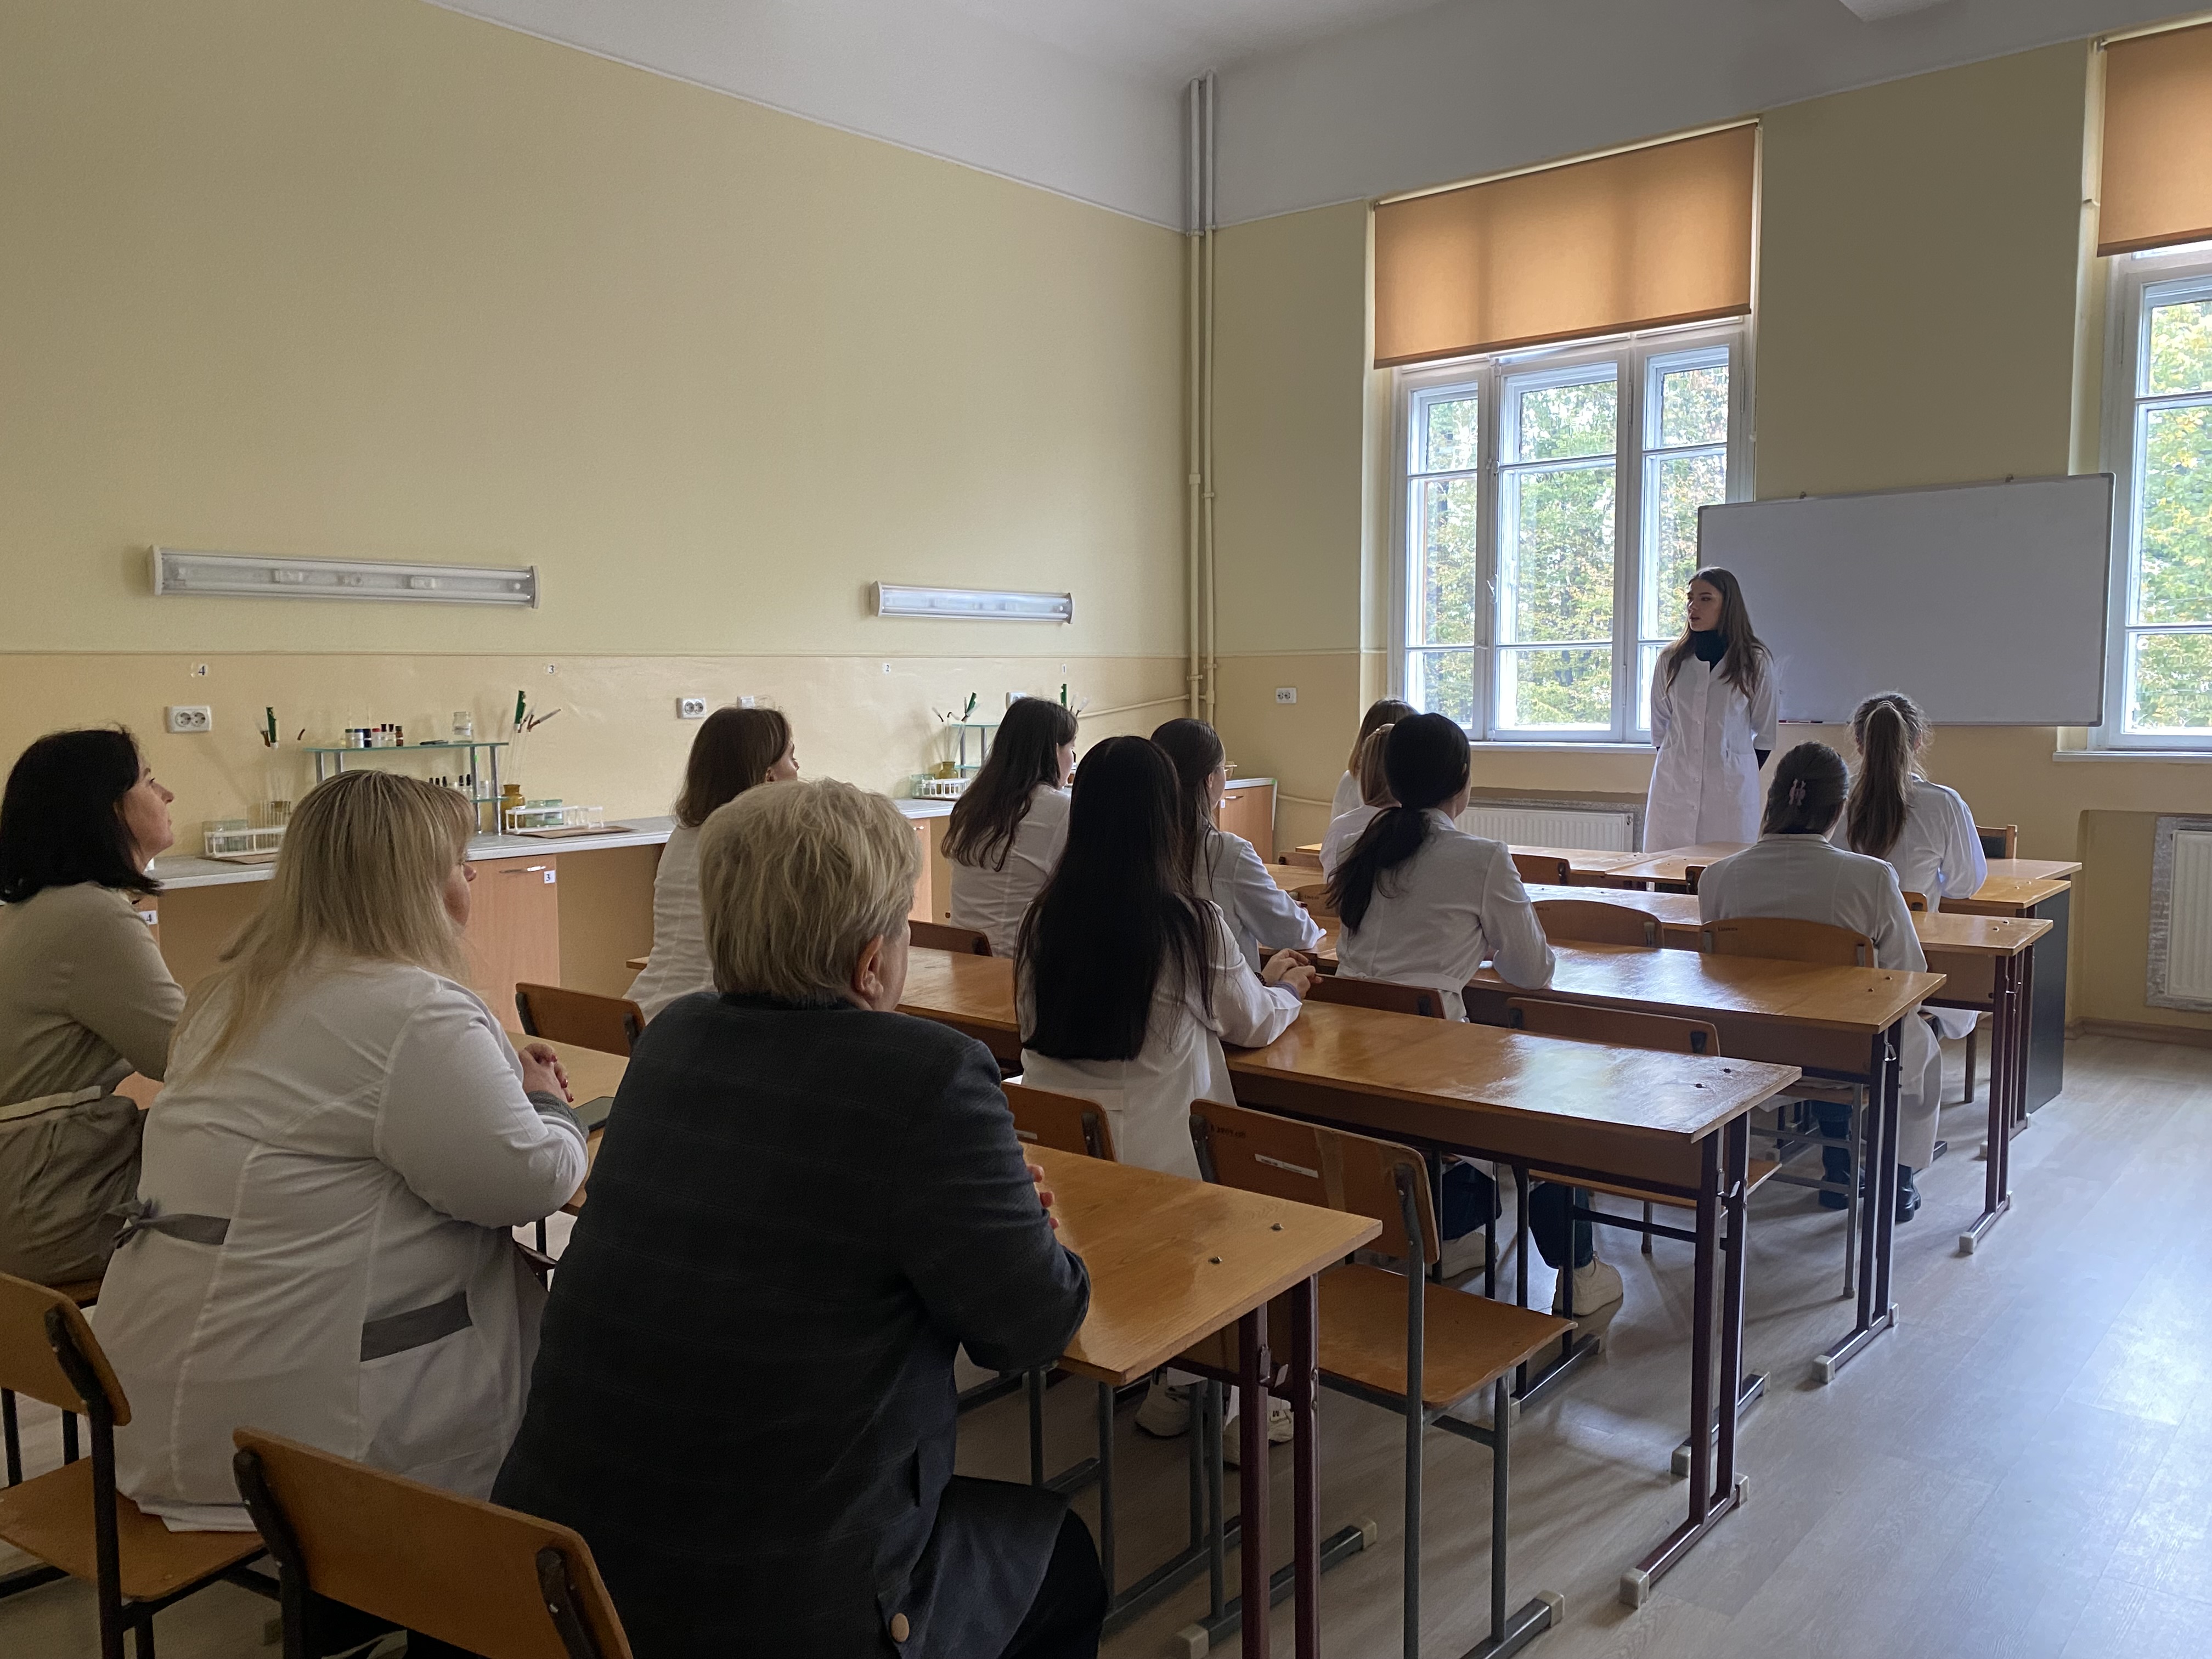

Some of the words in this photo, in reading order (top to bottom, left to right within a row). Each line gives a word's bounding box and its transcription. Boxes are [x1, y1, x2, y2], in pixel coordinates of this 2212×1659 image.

[198, 665, 205, 675] 4
[549, 665, 554, 674] 3
[146, 914, 152, 922] 4
